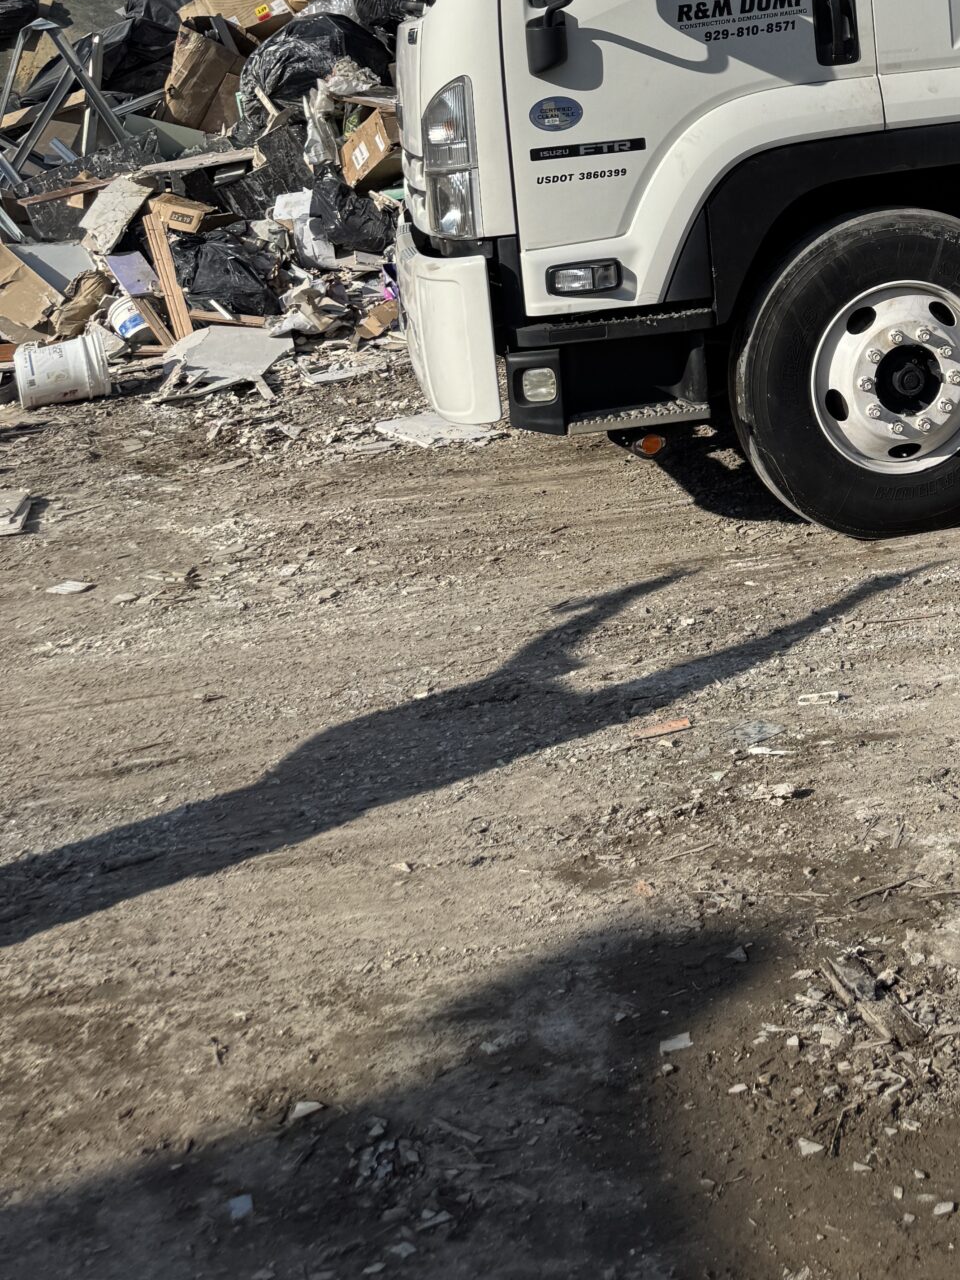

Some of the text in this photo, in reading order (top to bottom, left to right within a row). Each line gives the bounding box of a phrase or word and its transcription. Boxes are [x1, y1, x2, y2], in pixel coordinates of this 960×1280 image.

[680, 17, 731, 31] CONSTRUCTION
[737, 12, 779, 23] DEMOLITION
[779, 8, 808, 18] HAULING
[704, 20, 796, 42] 929-810-8571
[540, 140, 631, 158] ISUZU FTR
[537, 168, 627, 185] USDOT 3860399
